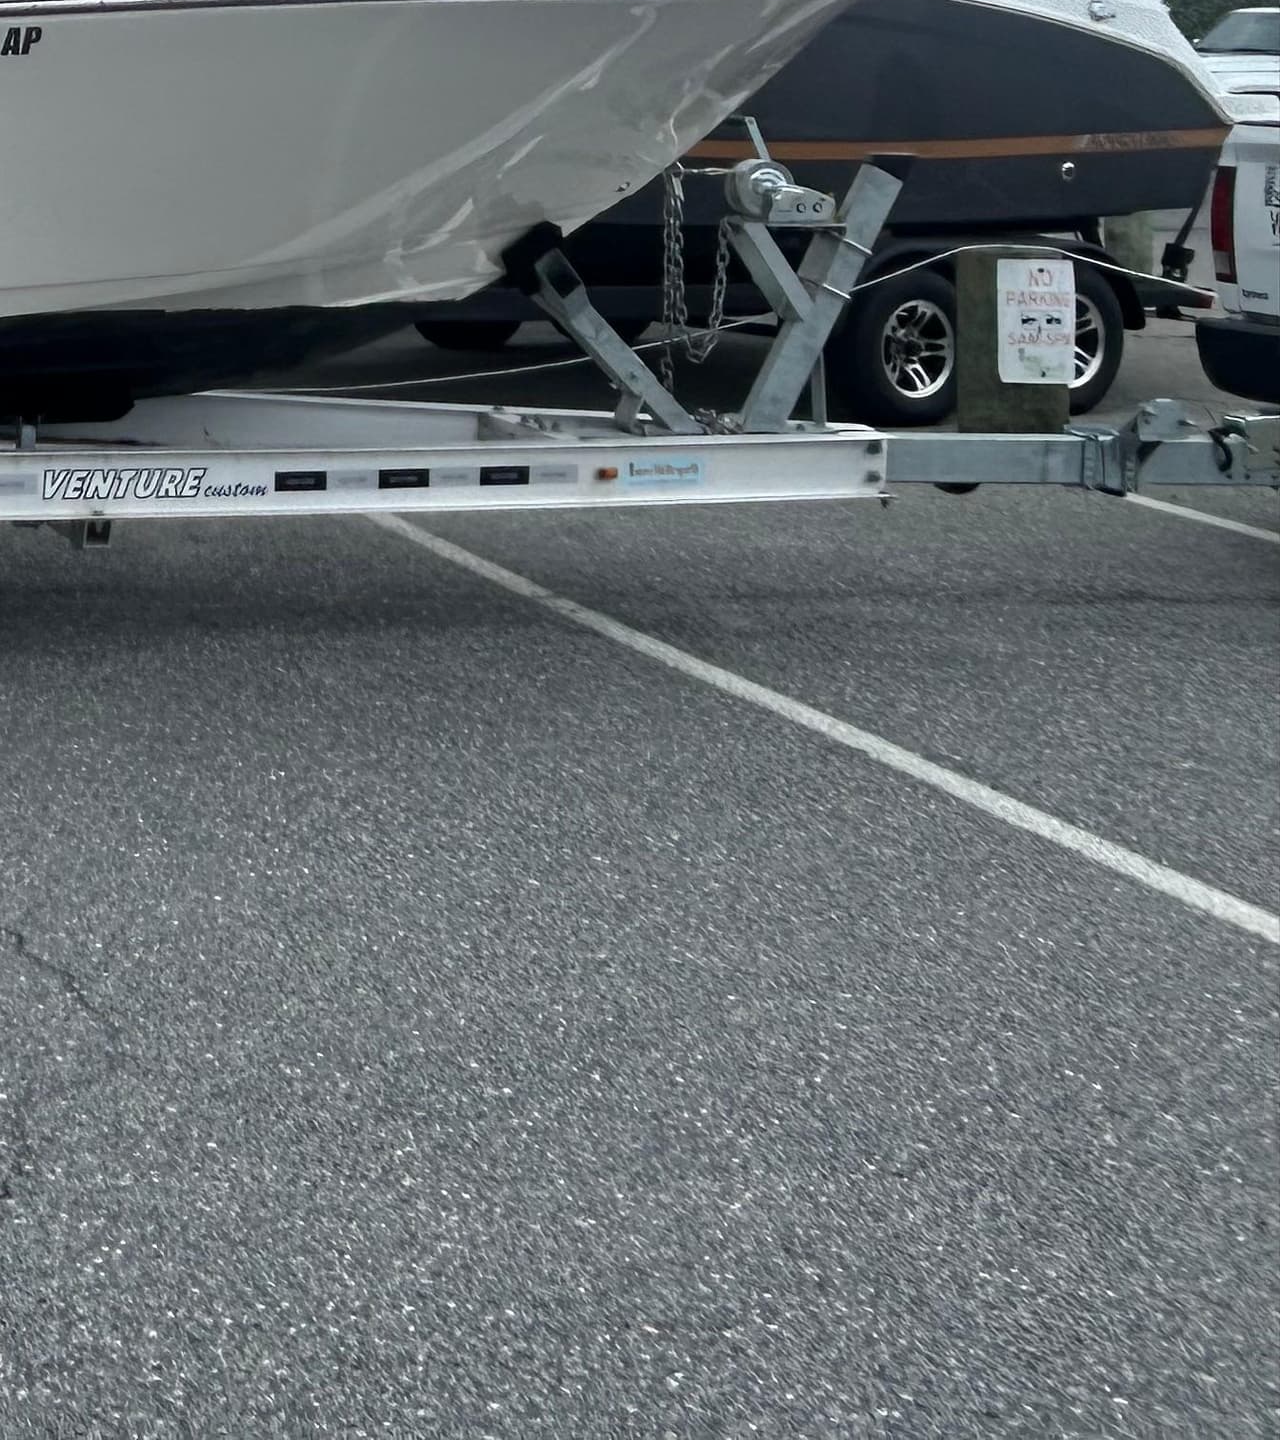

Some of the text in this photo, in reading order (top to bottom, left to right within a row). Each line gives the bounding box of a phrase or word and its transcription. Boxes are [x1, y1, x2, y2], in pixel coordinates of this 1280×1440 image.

[0, 25, 43, 56] AP
[42, 467, 268, 500] VENTURE custom
